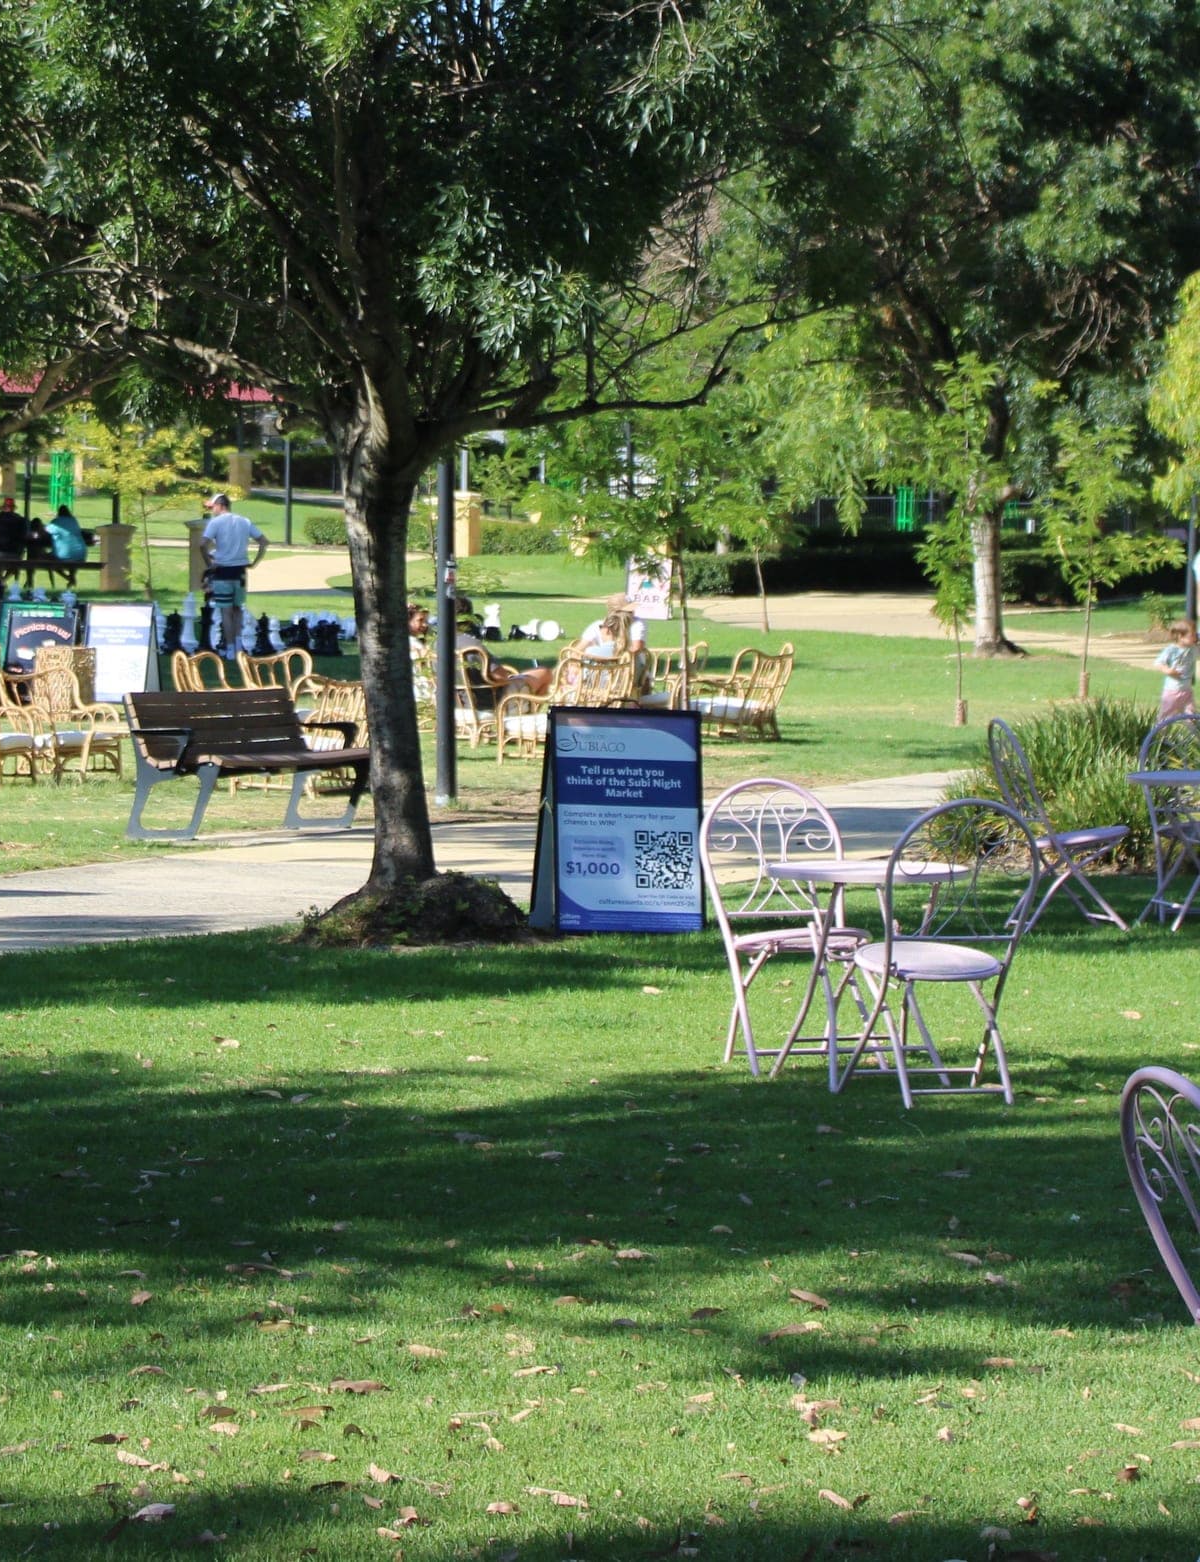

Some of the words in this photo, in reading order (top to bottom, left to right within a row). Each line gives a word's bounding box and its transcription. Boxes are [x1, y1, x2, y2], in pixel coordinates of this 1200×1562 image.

[633, 594, 661, 603] BAR
[557, 731, 626, 752] SUBIACO
[581, 766, 601, 775] Tell
[617, 767, 643, 776] what
[645, 769, 665, 778] you
[567, 776, 593, 785] think
[595, 777, 607, 786] of
[609, 777, 626, 786] the
[628, 778, 650, 787] Subi
[653, 779, 681, 790] Night
[605, 788, 643, 798] Market
[566, 861, 621, 877] $1,000
